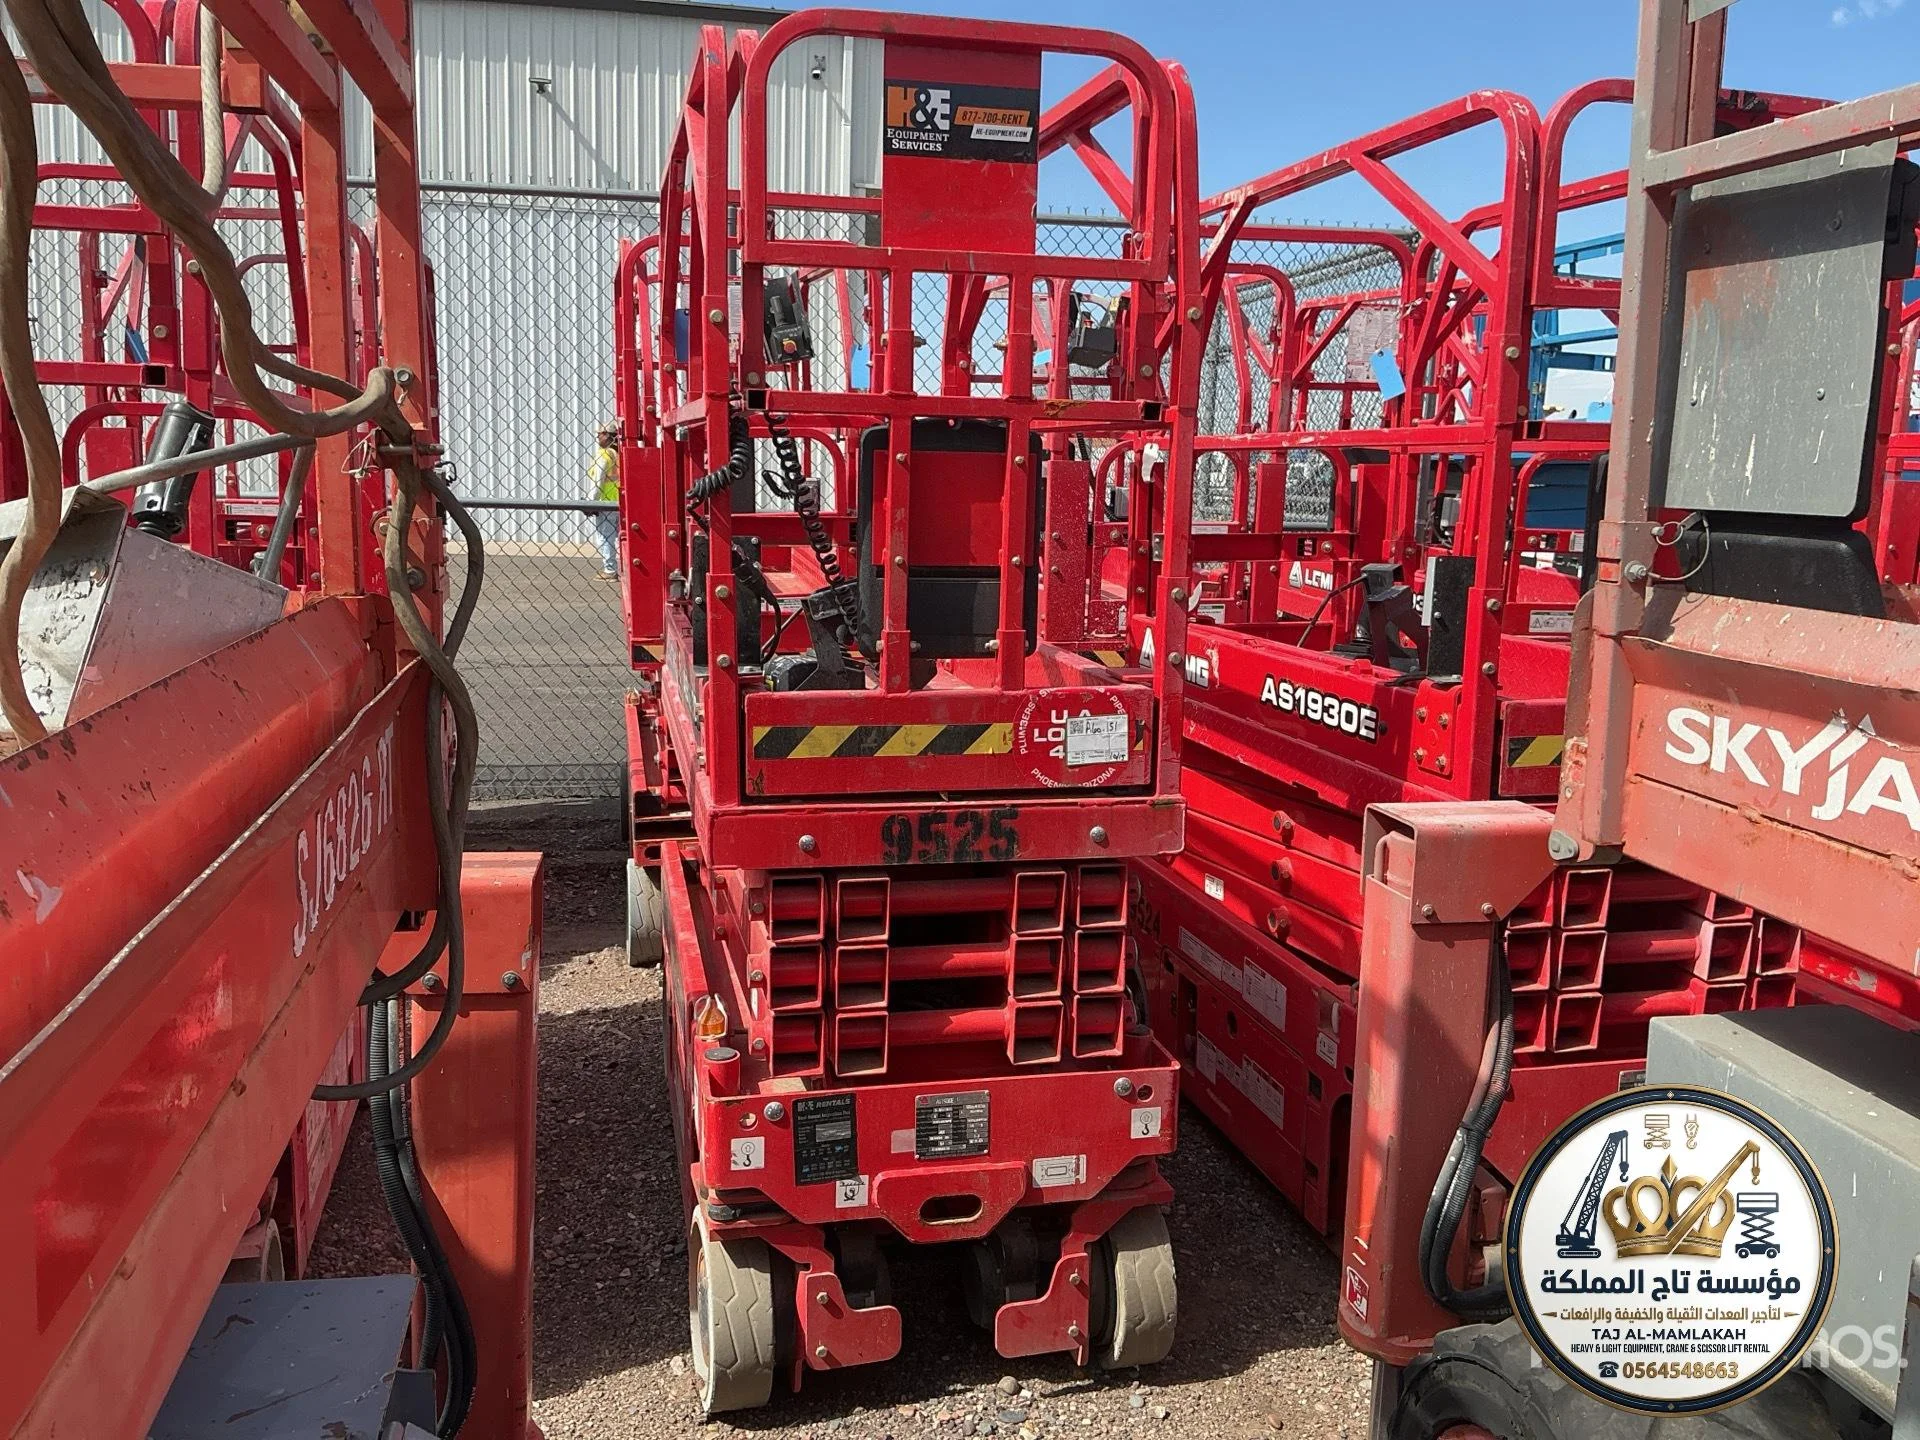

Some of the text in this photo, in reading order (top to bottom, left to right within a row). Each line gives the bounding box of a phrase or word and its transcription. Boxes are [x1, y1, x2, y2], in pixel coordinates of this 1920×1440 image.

[887, 86, 950, 130] H&E
[961, 110, 1024, 125] 877-700-RENT
[892, 138, 942, 151] SERVICES
[1261, 677, 1377, 740] AS1930E
[293, 755, 374, 958] SJ6826
[881, 807, 1019, 864] 9525
